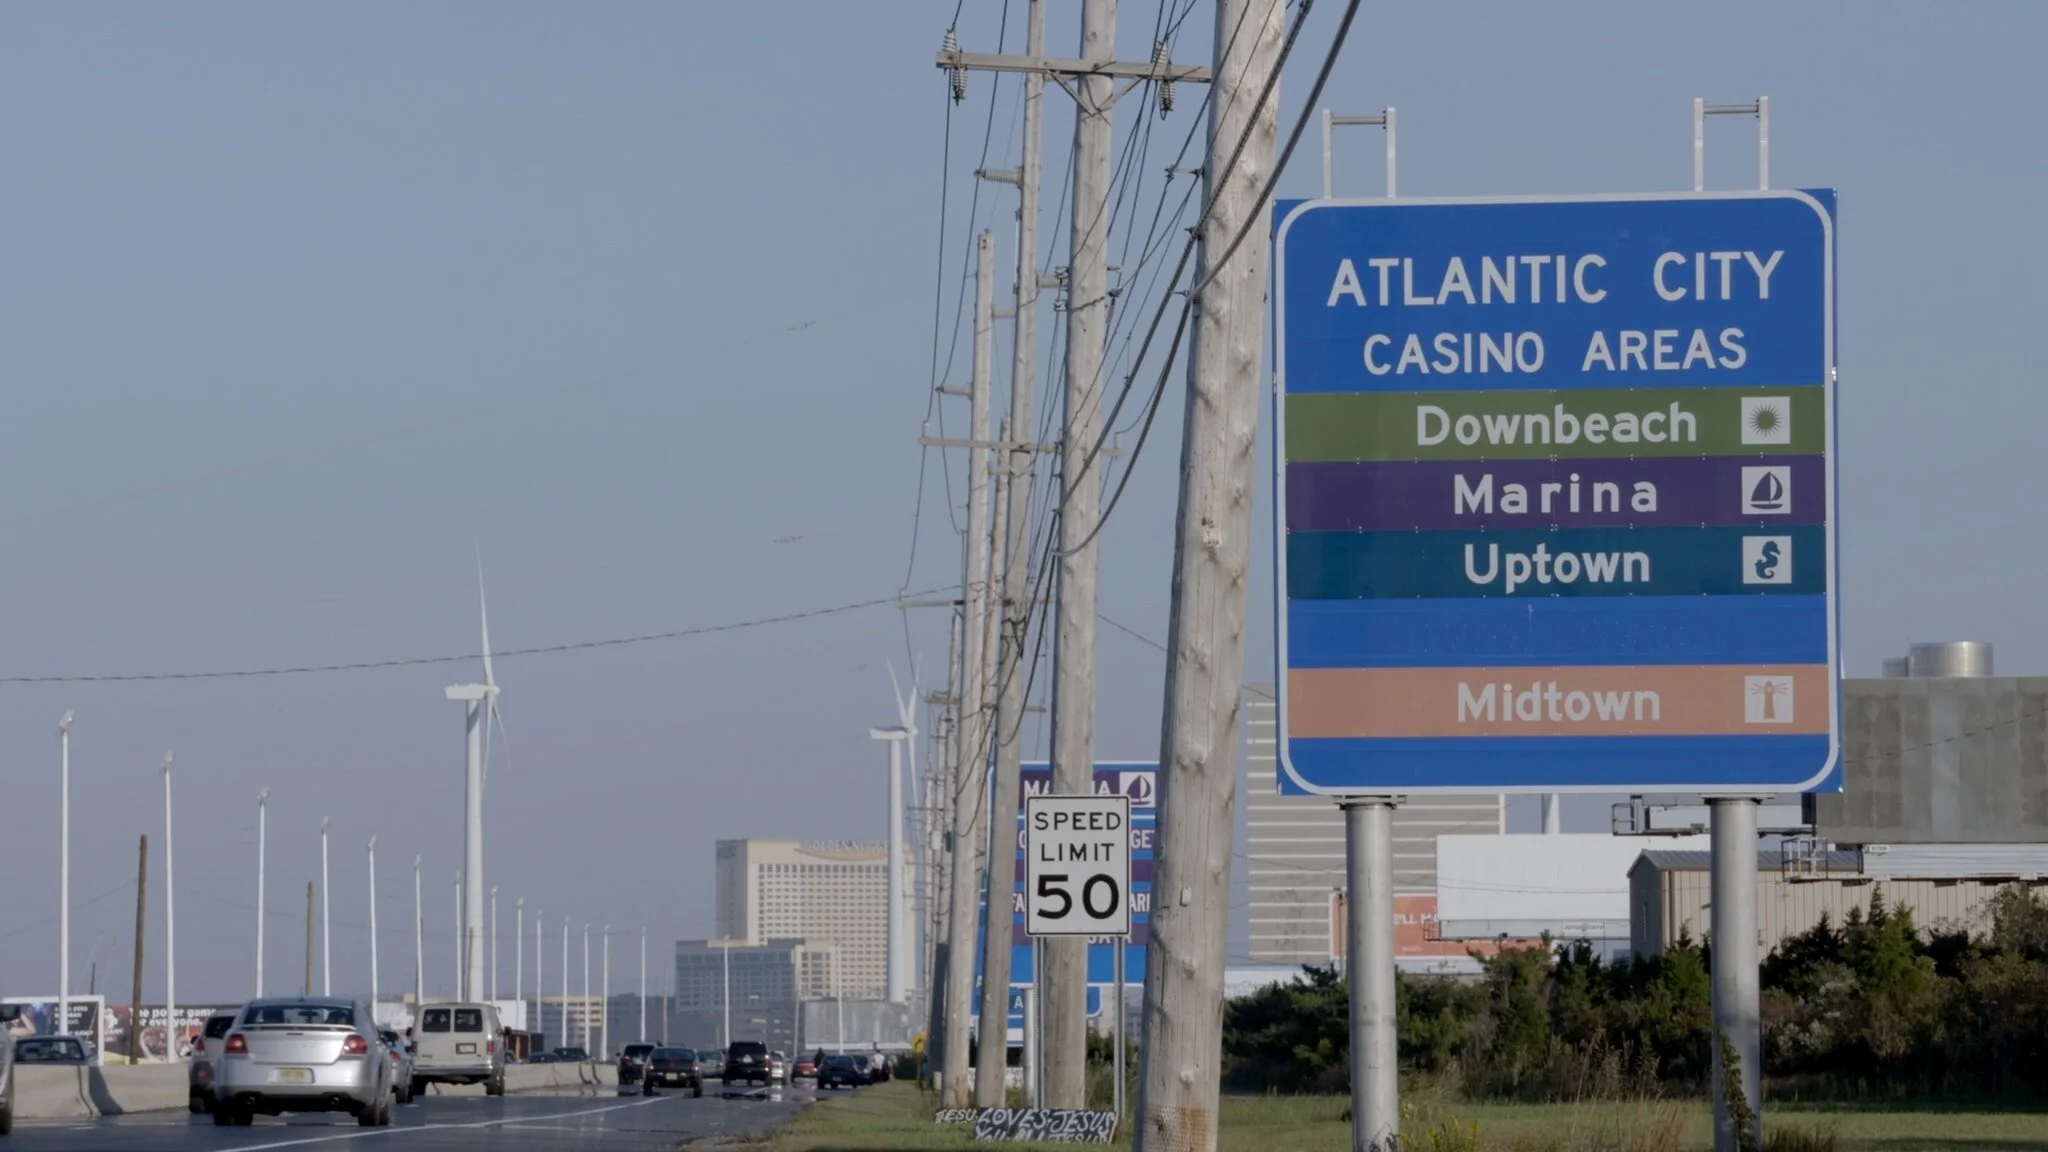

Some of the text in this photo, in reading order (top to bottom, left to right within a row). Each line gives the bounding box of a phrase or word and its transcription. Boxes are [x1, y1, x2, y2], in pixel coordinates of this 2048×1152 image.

[1326, 250, 1785, 307] ATLANTIC CITY
[1363, 327, 1748, 376] CASINO AREAS
[1416, 401, 1698, 447] Downbeach
[1453, 472, 1658, 515] Marina
[1463, 541, 1651, 595] Uptown
[1456, 680, 1661, 722] Midtown
[1034, 811, 1121, 831] SPEED
[1040, 842, 1115, 862] LIMIT
[1036, 873, 1120, 920] 50
[148, 1017, 203, 1028] eveyone.
[152, 1008, 185, 1019] poer
